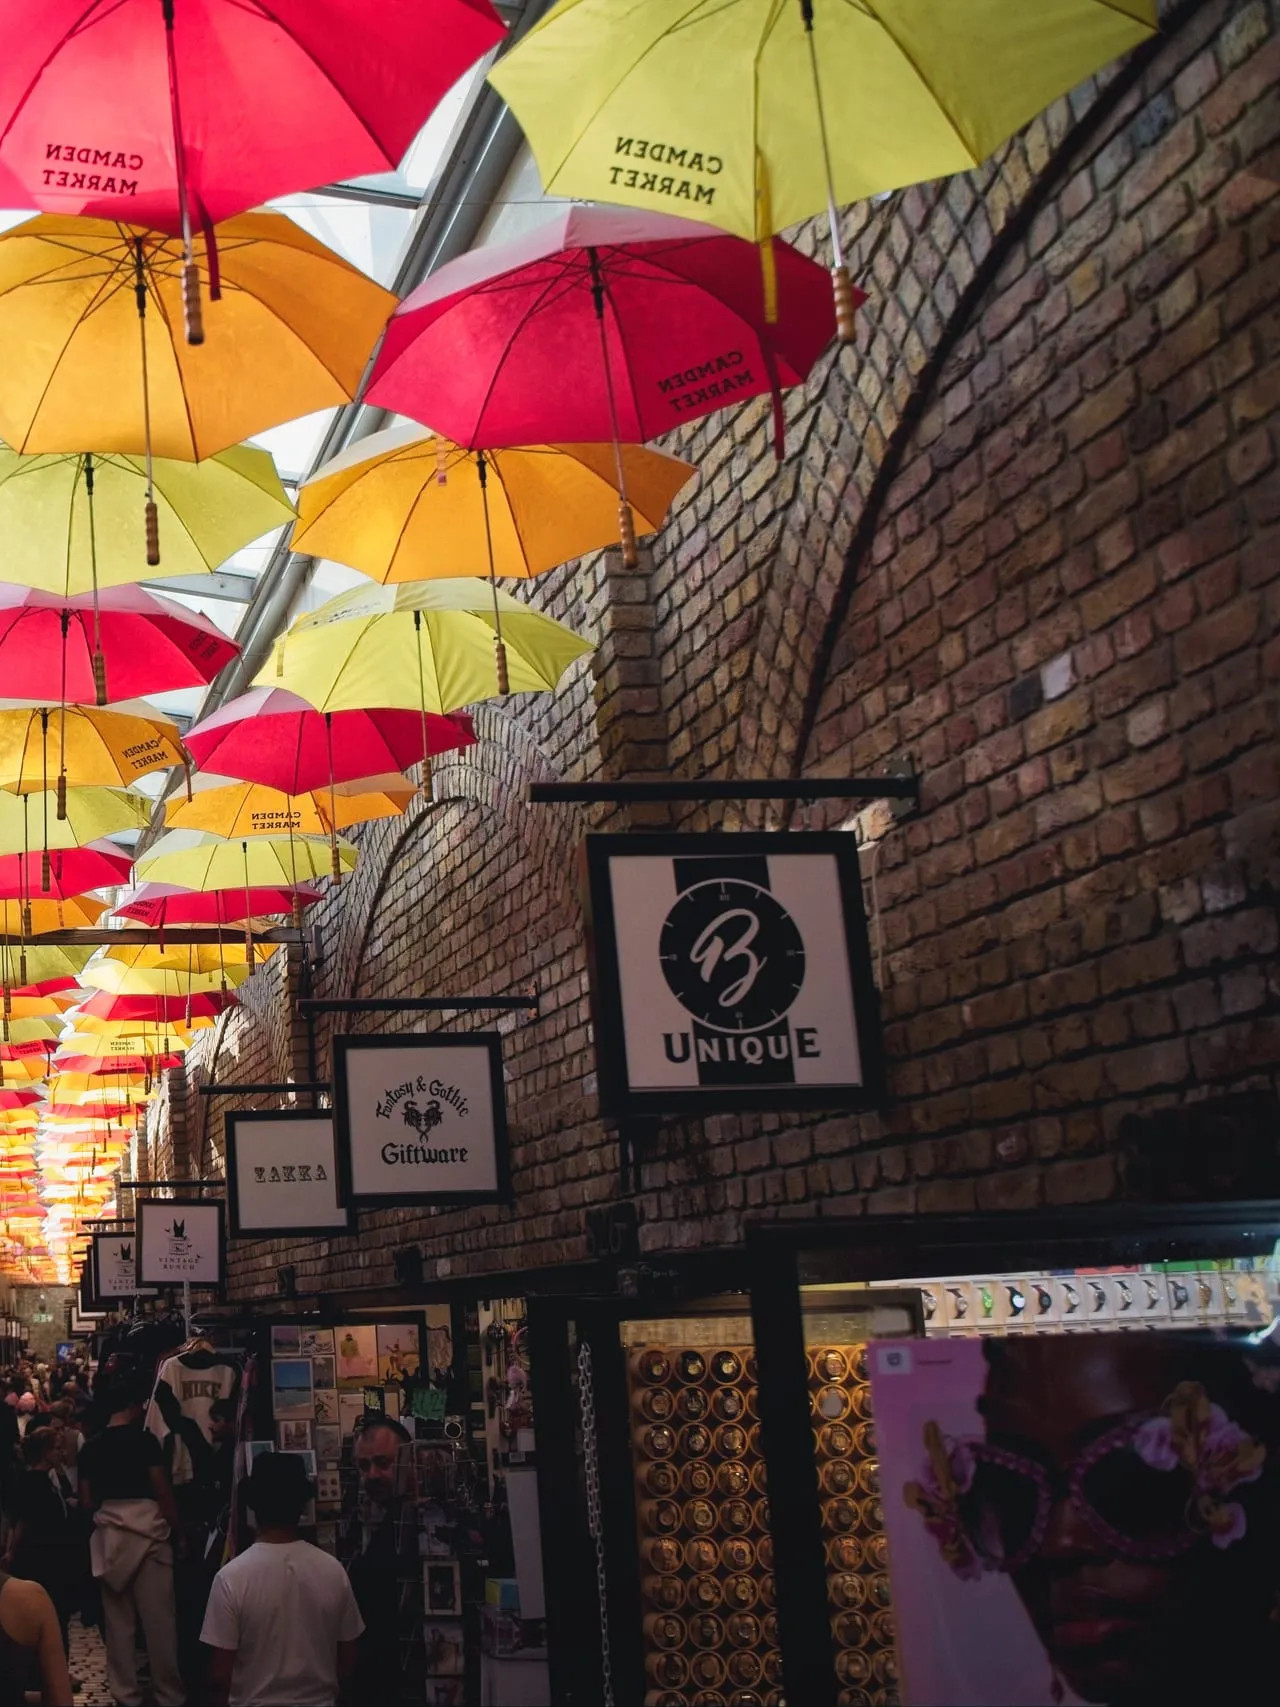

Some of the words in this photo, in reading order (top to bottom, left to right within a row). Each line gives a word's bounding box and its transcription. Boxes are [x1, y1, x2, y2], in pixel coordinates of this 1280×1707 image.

[662, 1027, 821, 1065] UNIQUE
[376, 1081, 415, 1119] Fantasy
[416, 1075, 427, 1093] &
[429, 1079, 470, 1118] Gothic
[381, 1142, 469, 1165] Giftware
